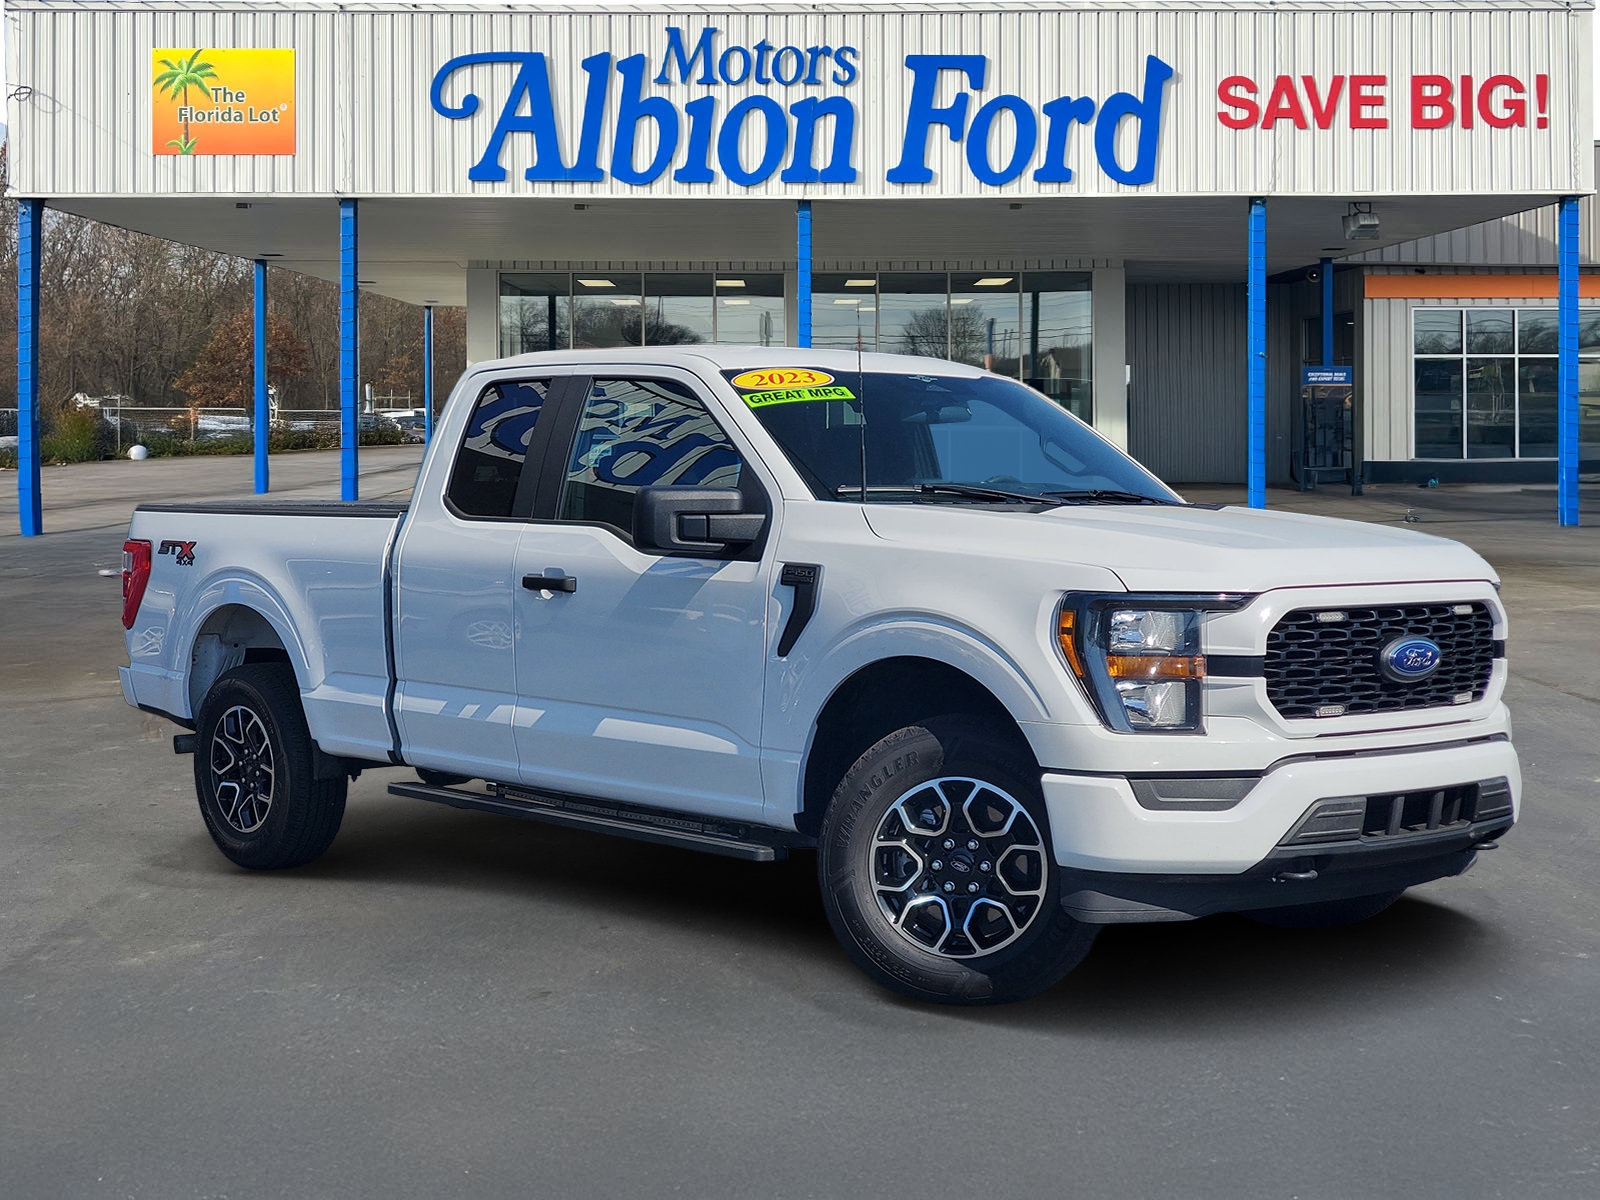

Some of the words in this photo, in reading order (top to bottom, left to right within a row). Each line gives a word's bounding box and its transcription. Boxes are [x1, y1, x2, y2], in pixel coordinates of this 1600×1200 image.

[653, 27, 857, 85] Motors
[211, 86, 246, 103] The
[1216, 74, 1388, 130] SAVE
[1411, 74, 1549, 129] BIG!
[178, 106, 244, 122] Florida
[248, 106, 279, 122] Lot
[430, 51, 857, 186] Albion
[886, 54, 1175, 186] Ford
[750, 371, 817, 387] 2023
[748, 389, 805, 404] GREAT
[808, 387, 845, 398] MPG
[158, 540, 197, 560] STX
[838, 750, 920, 849] WRANGLER
